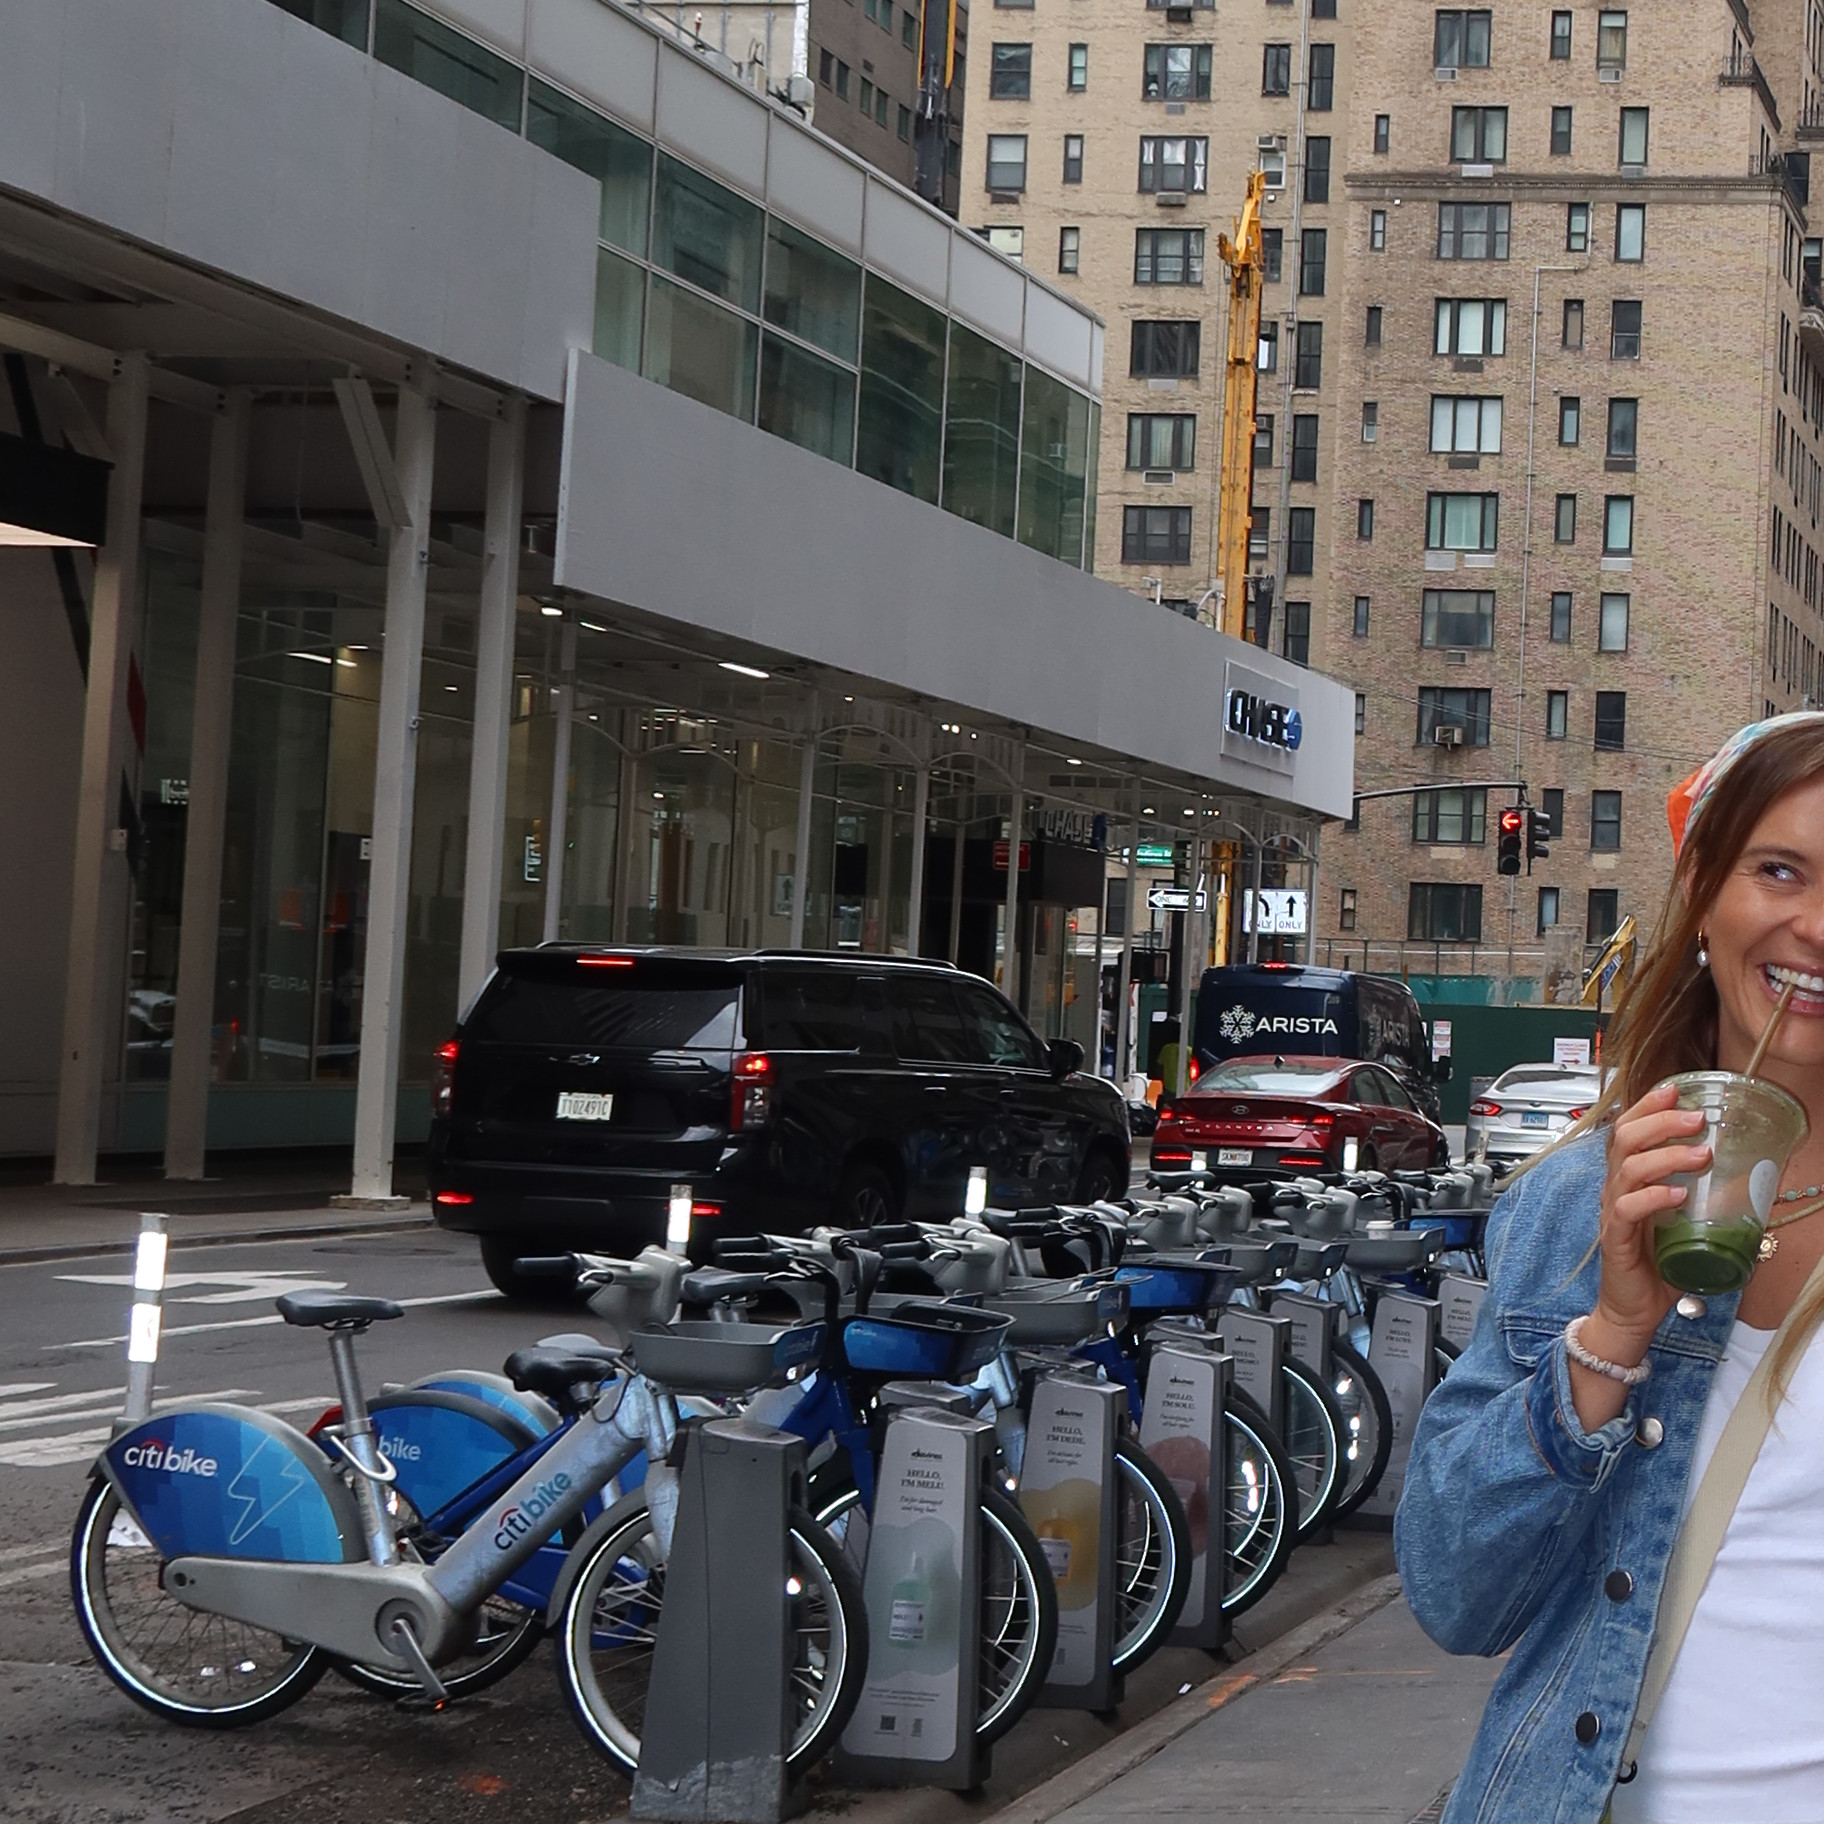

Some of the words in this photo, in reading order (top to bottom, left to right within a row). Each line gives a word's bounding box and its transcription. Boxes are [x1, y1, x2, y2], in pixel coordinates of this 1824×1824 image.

[1279, 921, 1303, 929] ONLY
[1255, 1017, 1339, 1035] ARISTA
[907, 1469, 942, 1480] HELLO,
